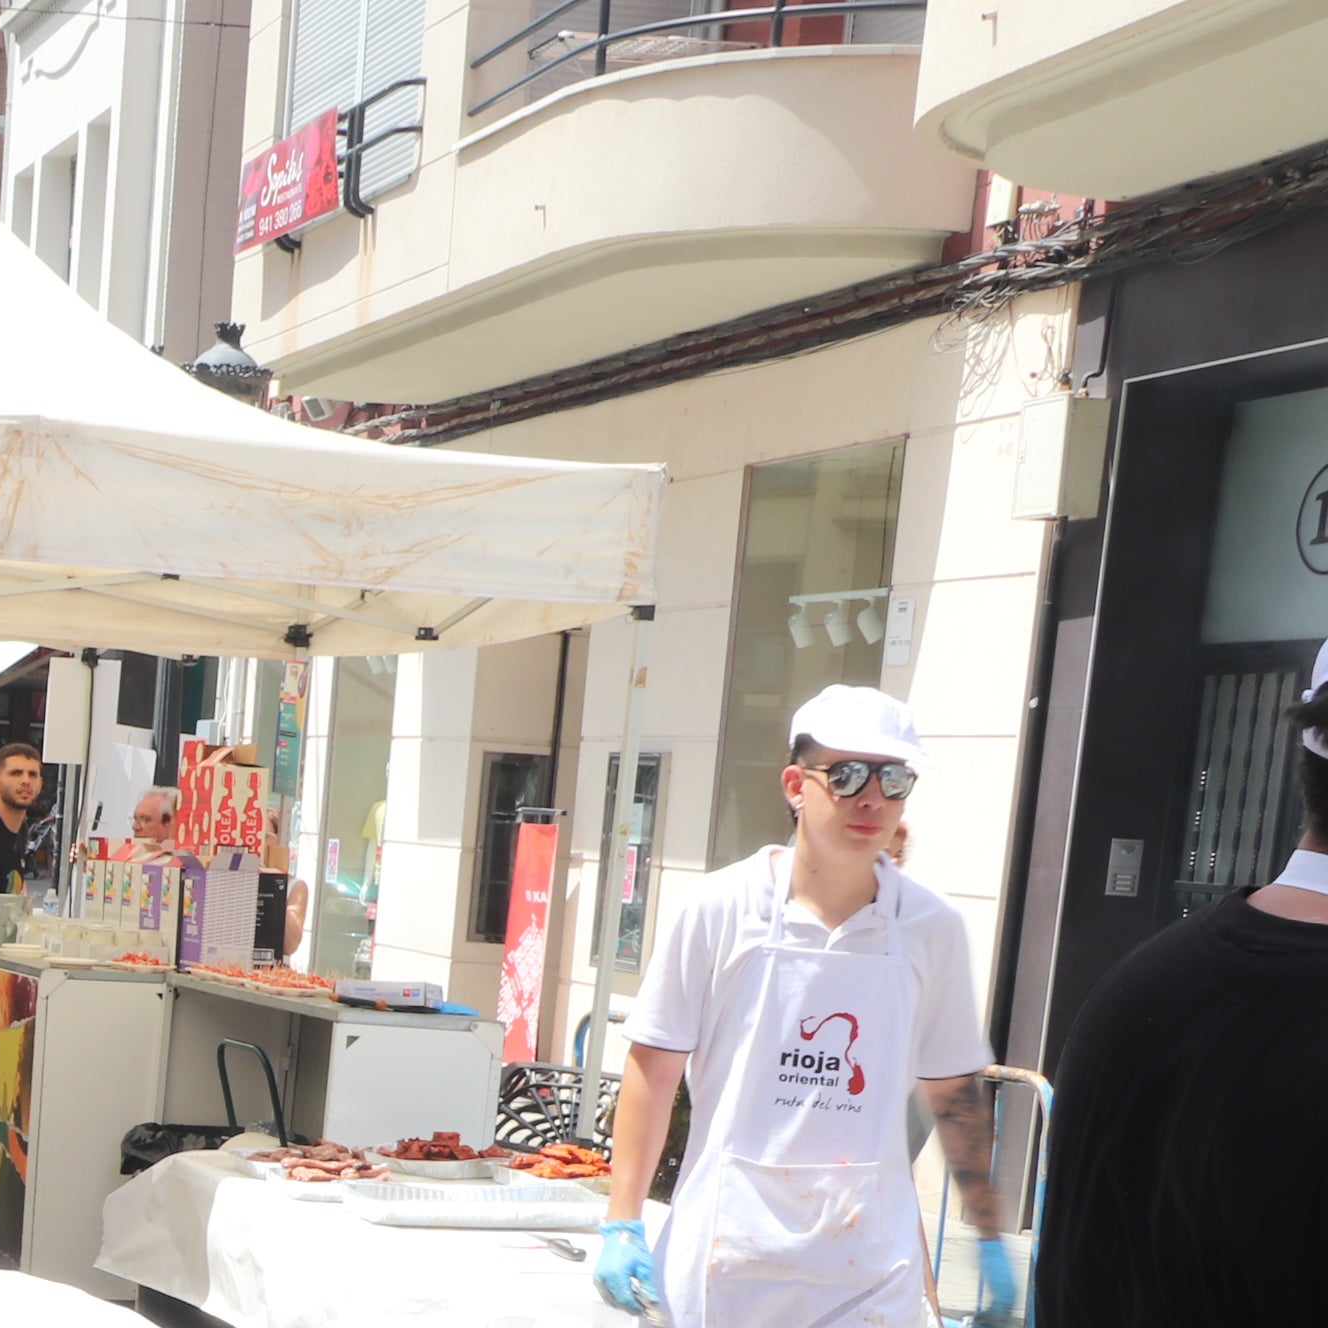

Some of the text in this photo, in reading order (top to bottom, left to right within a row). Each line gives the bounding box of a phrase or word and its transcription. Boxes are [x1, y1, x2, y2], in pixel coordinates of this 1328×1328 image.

[780, 1049, 840, 1074] rioja
[778, 1073, 839, 1087] oriental
[812, 1092, 832, 1110] del
